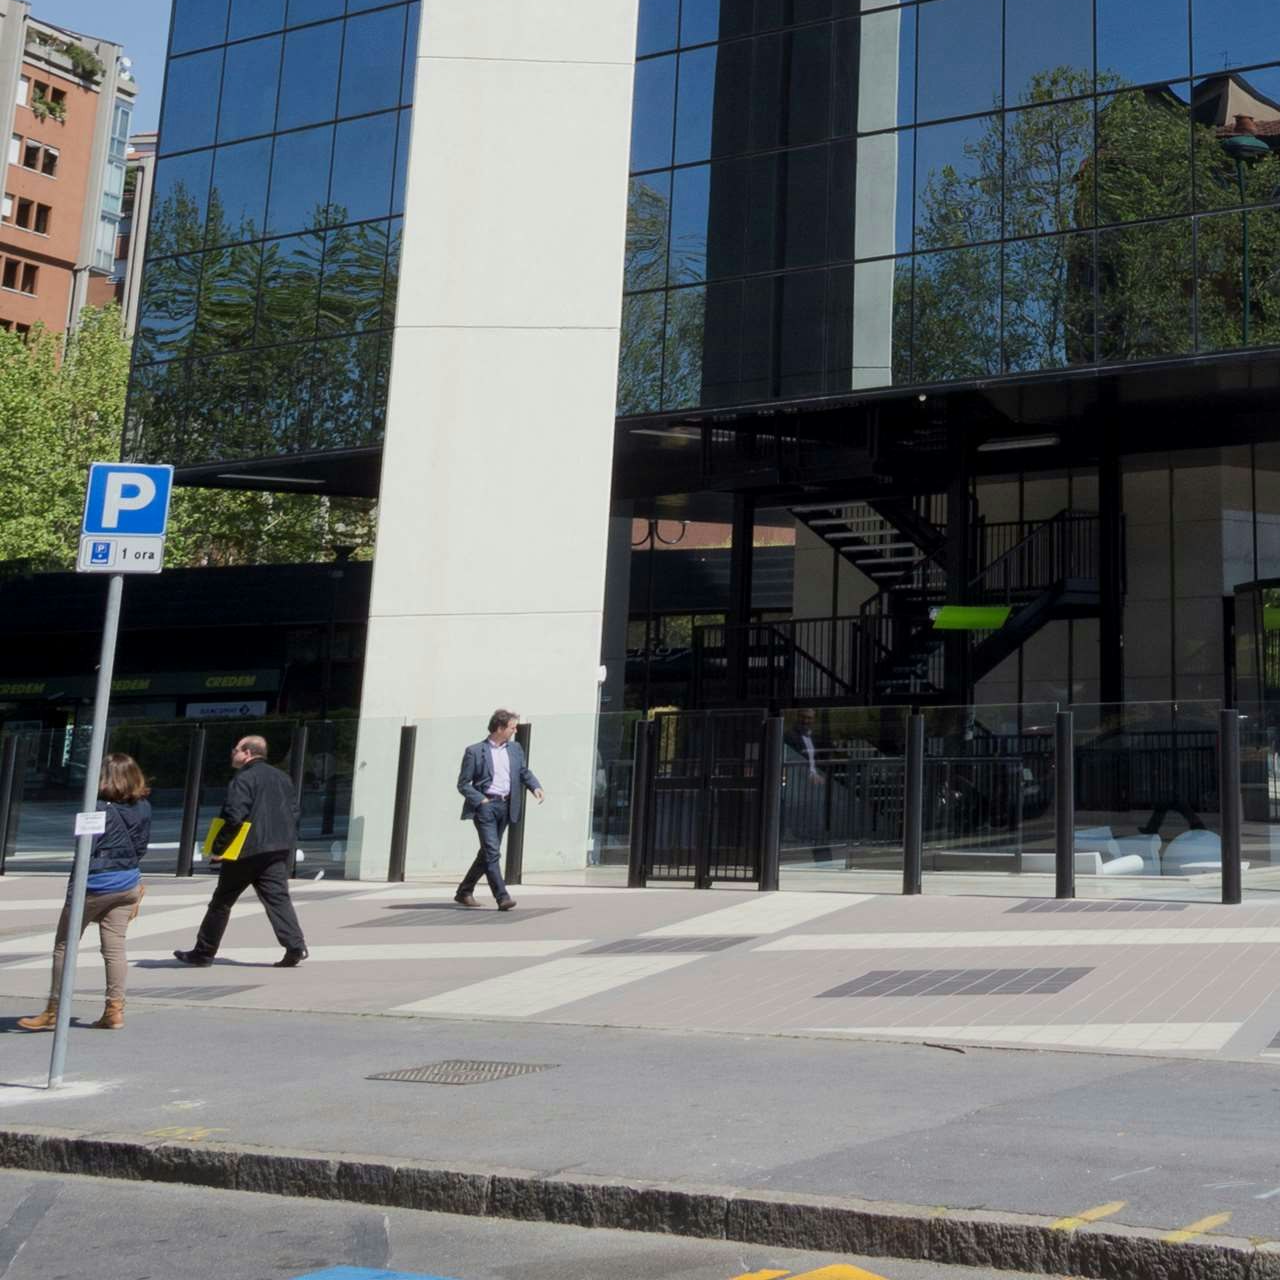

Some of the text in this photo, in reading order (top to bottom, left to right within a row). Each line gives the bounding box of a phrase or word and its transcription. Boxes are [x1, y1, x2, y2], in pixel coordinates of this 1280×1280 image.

[101, 472, 156, 528] P
[121, 548, 155, 560] 1 ora
[205, 675, 256, 688] CREDEM
